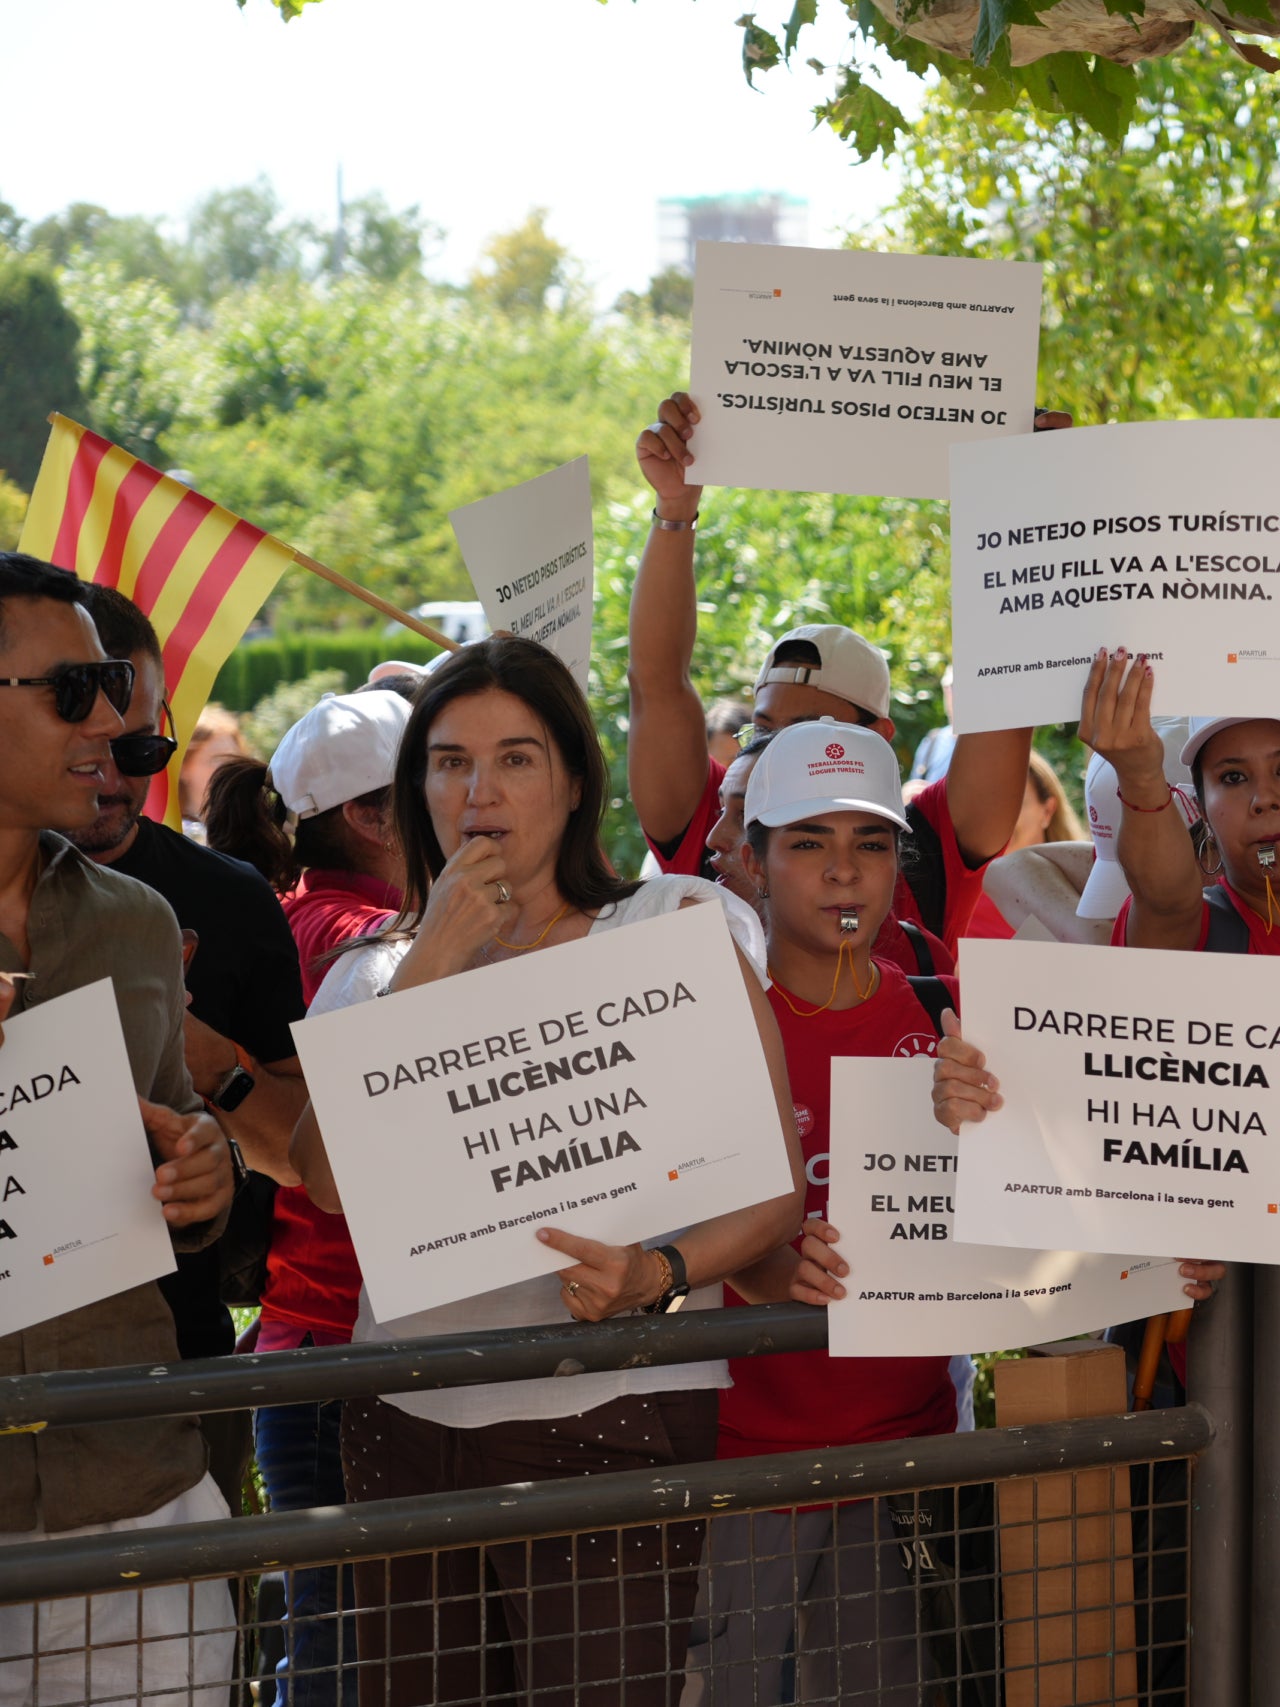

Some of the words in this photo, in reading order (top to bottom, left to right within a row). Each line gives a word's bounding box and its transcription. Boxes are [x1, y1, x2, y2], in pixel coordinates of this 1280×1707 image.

[833, 294, 855, 302] gent
[881, 298, 889, 306] la
[897, 299, 944, 309] Barcelona
[946, 302, 967, 310] amb
[969, 304, 1015, 314] APARTUR
[743, 339, 832, 361] NÒMINA.
[839, 345, 935, 365] AQUESTA
[941, 352, 988, 368] AMB
[724, 360, 820, 380] L'ESCOLA
[827, 367, 842, 381] A
[847, 368, 876, 384] VA
[882, 370, 922, 387] FILL
[929, 374, 972, 390] MEU
[979, 377, 1002, 392] EL
[717, 393, 825, 415] TURÍSTICS.
[831, 401, 890, 418] PISOS
[897, 405, 974, 423] NETEJO
[981, 410, 1007, 425] JO
[977, 532, 1002, 550] JO
[1008, 521, 1086, 546] NETEJO
[1093, 515, 1161, 535] PISOS
[496, 585, 512, 603] JO
[540, 558, 558, 582] PISOS
[984, 571, 1006, 589] EL
[1012, 564, 1055, 585] MEU
[1062, 559, 1104, 579] FILL
[1110, 556, 1143, 573] VA
[1150, 555, 1168, 572] A
[1000, 593, 1044, 614] AMB
[1050, 583, 1154, 608] AQUESTA
[1163, 578, 1272, 600] NÒMINA.
[1238, 649, 1267, 657] APARTUR
[977, 664, 1021, 677] APARTUR
[1024, 661, 1044, 671] amb
[1046, 657, 1091, 669] Barcelona
[808, 767, 836, 776] LLOGUER
[1014, 1007, 1175, 1043] DARRERE
[1188, 1021, 1233, 1047] DE
[363, 1028, 531, 1097] DARRERE
[538, 1011, 588, 1046] DE
[597, 982, 696, 1027] CADA
[447, 1041, 636, 1114] LLICÈNCIA
[1085, 1051, 1270, 1088] LLICÈNCIA
[463, 1128, 500, 1159] HI
[509, 1112, 563, 1146] HA
[568, 1087, 647, 1126] UNA
[1088, 1099, 1119, 1124] HI
[1133, 1103, 1181, 1129] HA
[1193, 1107, 1267, 1136] UNA
[490, 1130, 642, 1193] FAMÍLIA
[676, 1156, 706, 1171] APARTUR
[864, 1154, 896, 1171] JO
[1104, 1138, 1249, 1173] FAMÍLIA
[871, 1195, 900, 1212] EL
[1004, 1183, 1063, 1195] APARTUR
[1066, 1188, 1092, 1197] amb
[1096, 1189, 1154, 1201] Barcelona
[1158, 1192, 1161, 1202] i
[1164, 1193, 1174, 1203] la
[1178, 1196, 1204, 1205] seva
[1207, 1199, 1234, 1208] gent
[410, 1233, 467, 1257] APARTUR
[470, 1224, 496, 1239] amb
[498, 1207, 558, 1230] Barcelona
[560, 1202, 565, 1212] i
[566, 1201, 578, 1210] la
[580, 1192, 607, 1206] seva
[610, 1182, 637, 1199] gent
[890, 1223, 948, 1240] AMB
[859, 1291, 915, 1301] APARTUR
[918, 1292, 944, 1301] amb
[947, 1291, 1003, 1301] Barcelona
[1005, 1289, 1009, 1298] i
[1011, 1290, 1020, 1298] la
[1024, 1288, 1046, 1296] seva
[1049, 1283, 1072, 1295] gent
